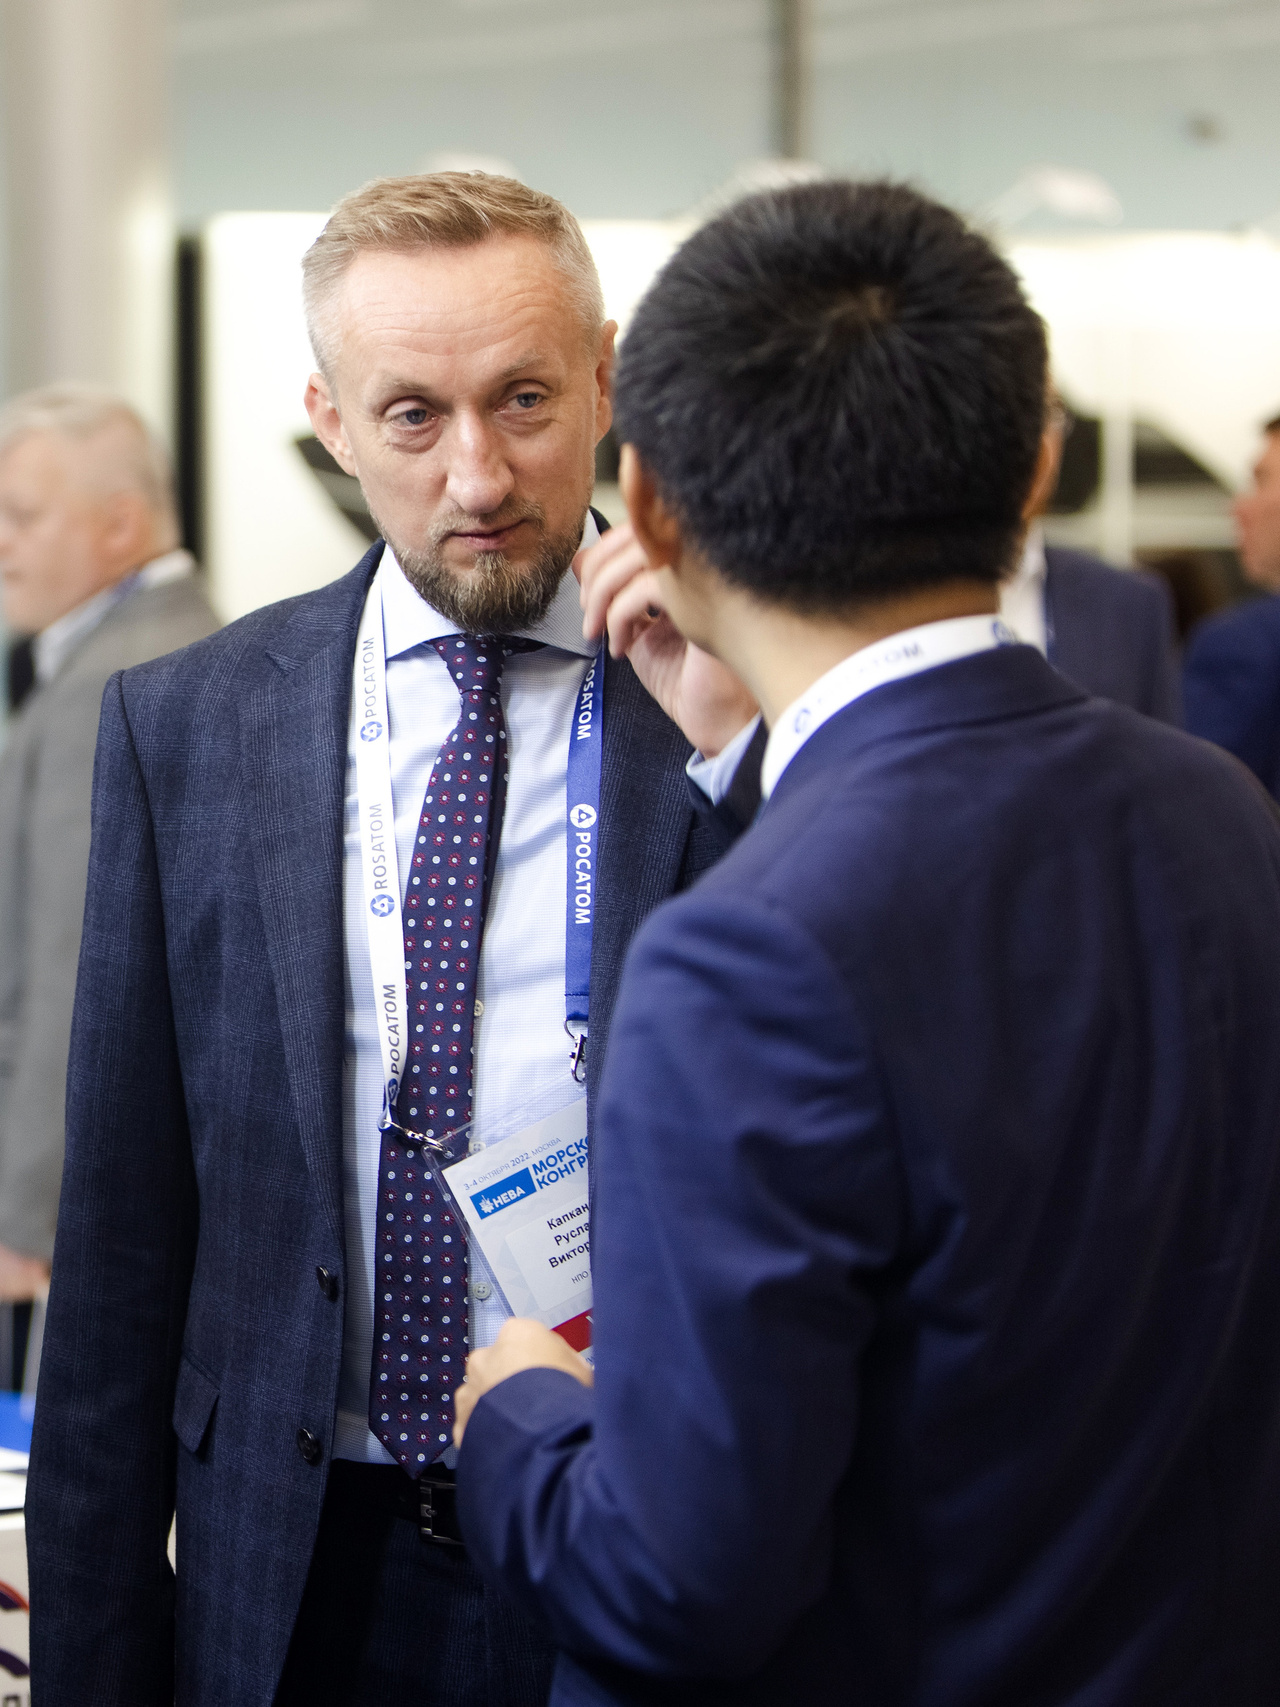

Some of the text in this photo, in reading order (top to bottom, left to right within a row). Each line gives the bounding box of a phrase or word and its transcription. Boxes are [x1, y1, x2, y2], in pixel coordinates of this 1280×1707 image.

[362, 637, 377, 718] РОСАТОМ
[368, 803, 388, 890] ROSATOM
[574, 832, 592, 925] РОСАТОМ
[382, 984, 401, 1076] РОСАТОМ
[463, 1179, 478, 1191] 3-4
[478, 1163, 510, 1184] ОКТЯБРЯ
[531, 1137, 562, 1157] МОСКВА
[492, 1186, 526, 1208] НЕВА
[571, 1270, 589, 1284] НПО
